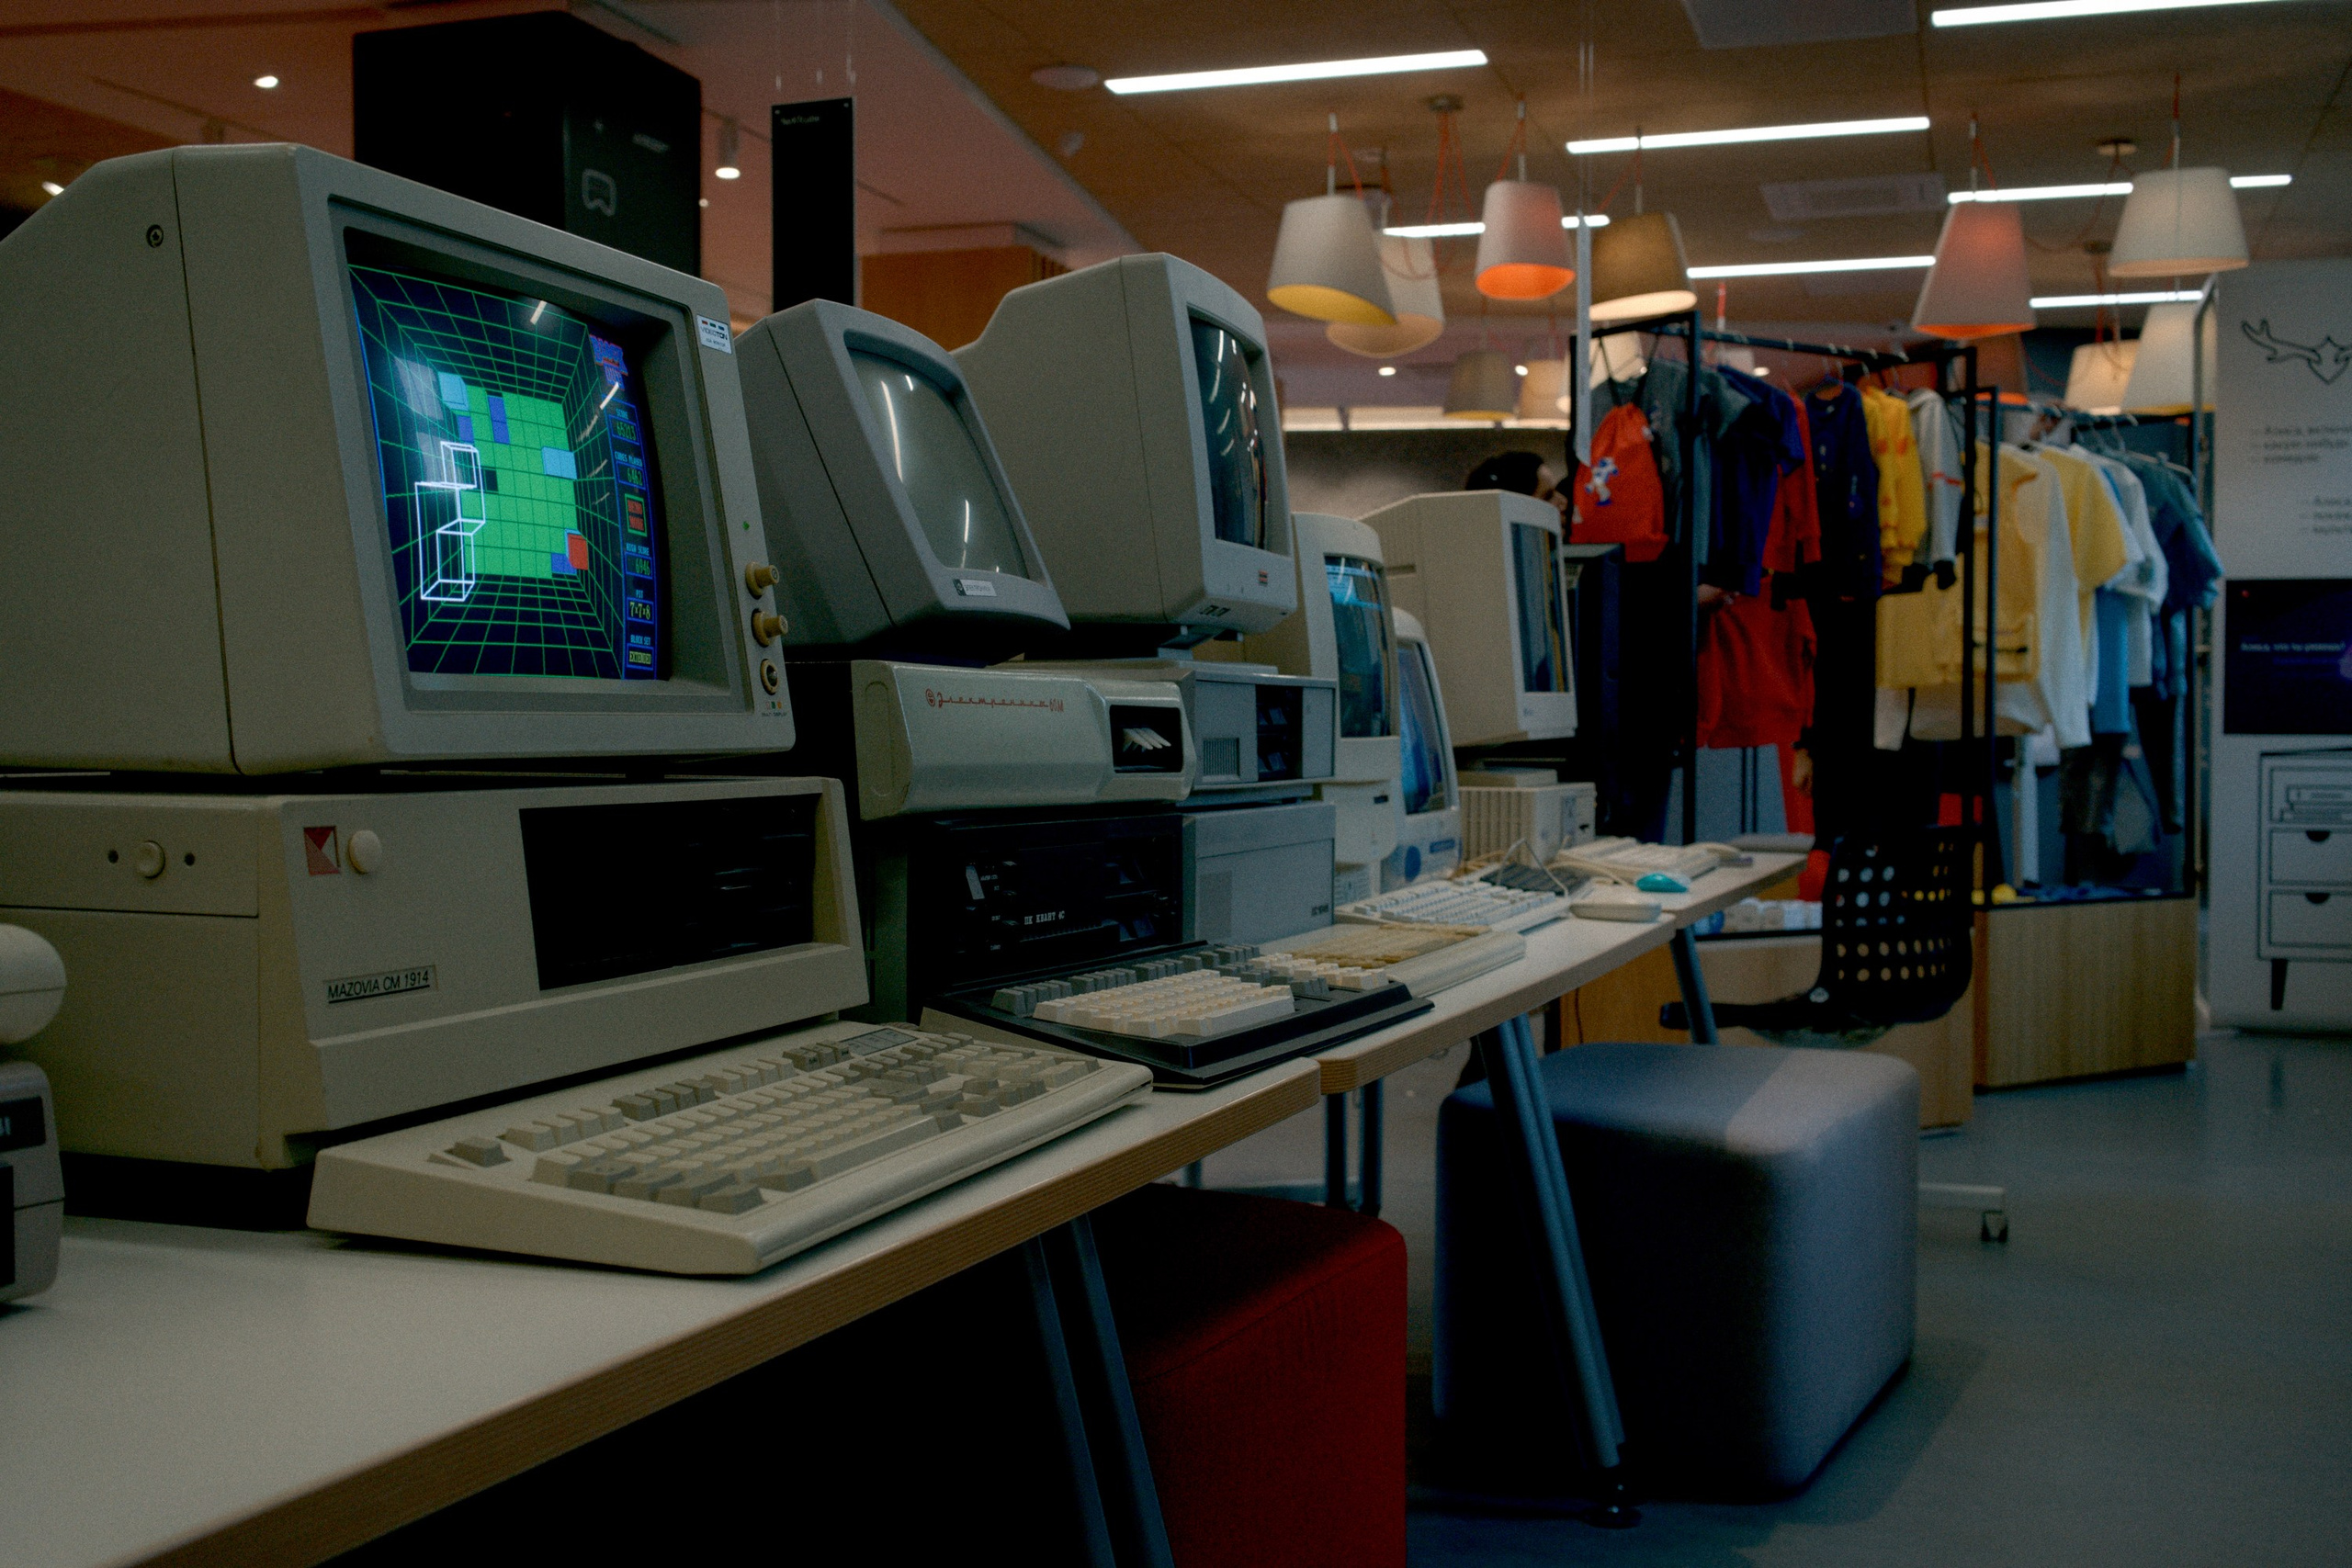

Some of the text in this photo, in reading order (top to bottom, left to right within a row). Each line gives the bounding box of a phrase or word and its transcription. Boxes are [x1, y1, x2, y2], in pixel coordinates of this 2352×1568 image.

[700, 326, 728, 341] VIDEOTON
[1035, 911, 1057, 923] КВАНТ
[328, 970, 429, 998] MAZOVIA CM 1914
